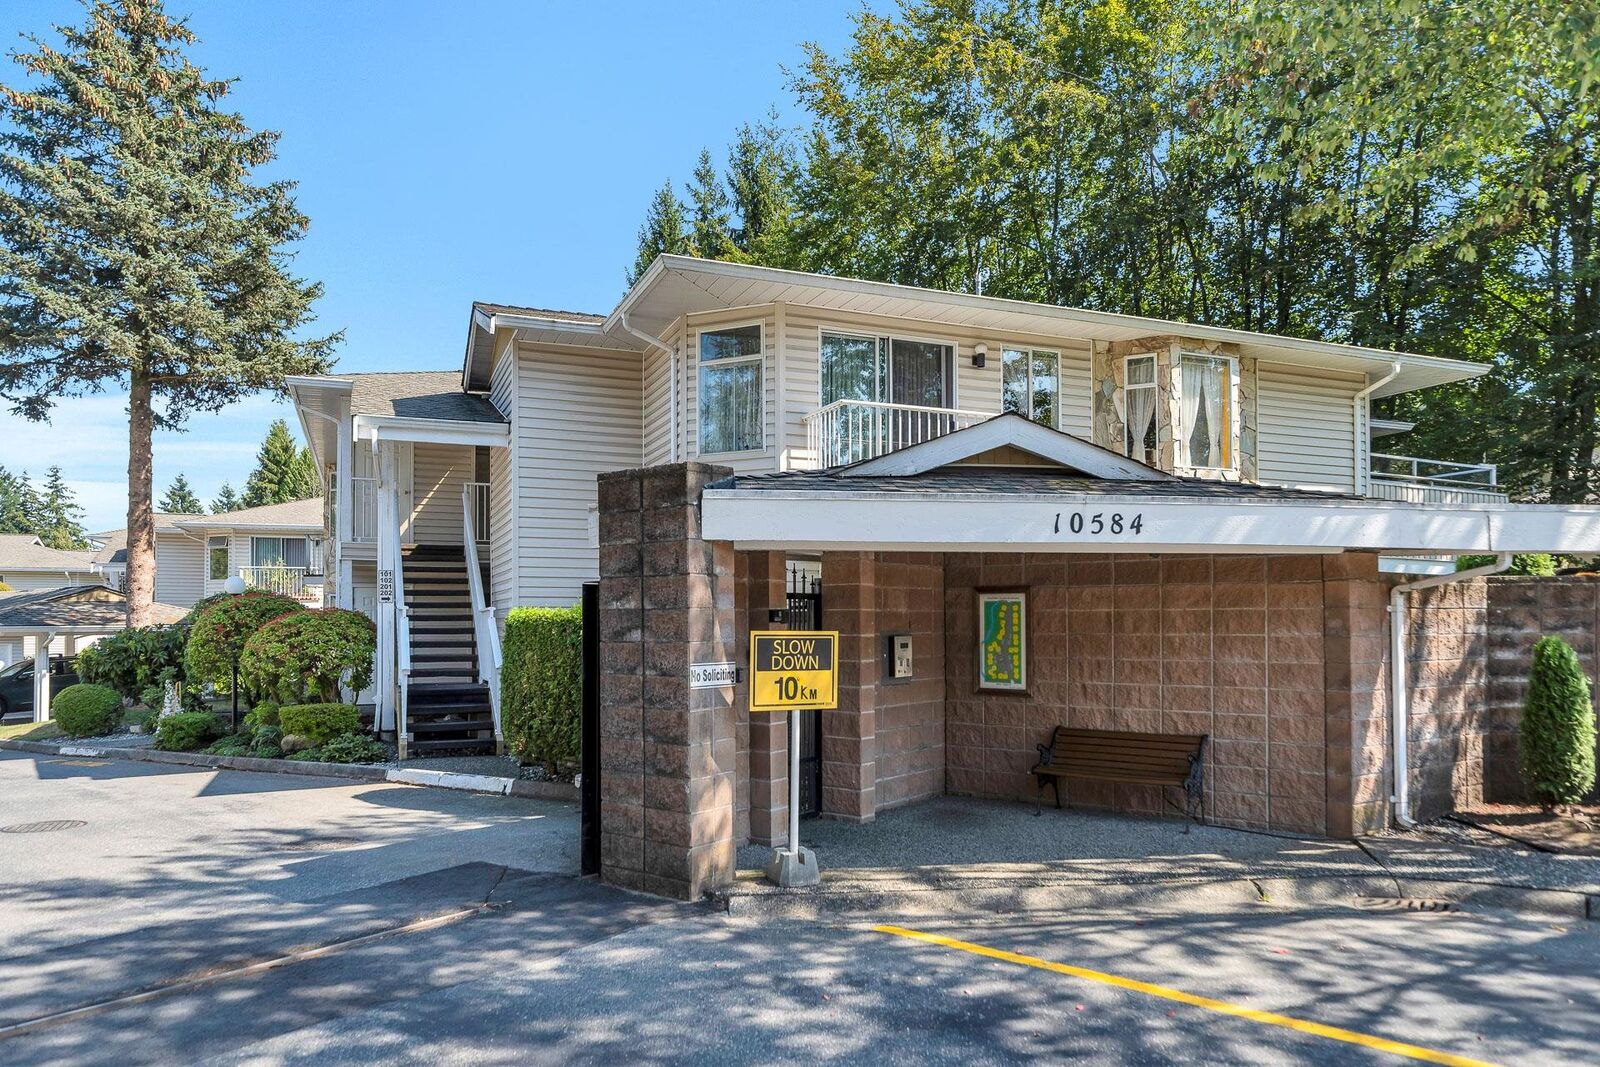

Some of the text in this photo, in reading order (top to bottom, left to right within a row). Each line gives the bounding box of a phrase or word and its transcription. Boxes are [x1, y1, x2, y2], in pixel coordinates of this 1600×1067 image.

[1054, 512, 1143, 535] 10584
[773, 639, 815, 655] SLOW
[771, 655, 819, 670] DOWN
[690, 668, 735, 683] No Soliciting
[774, 676, 798, 700] 10
